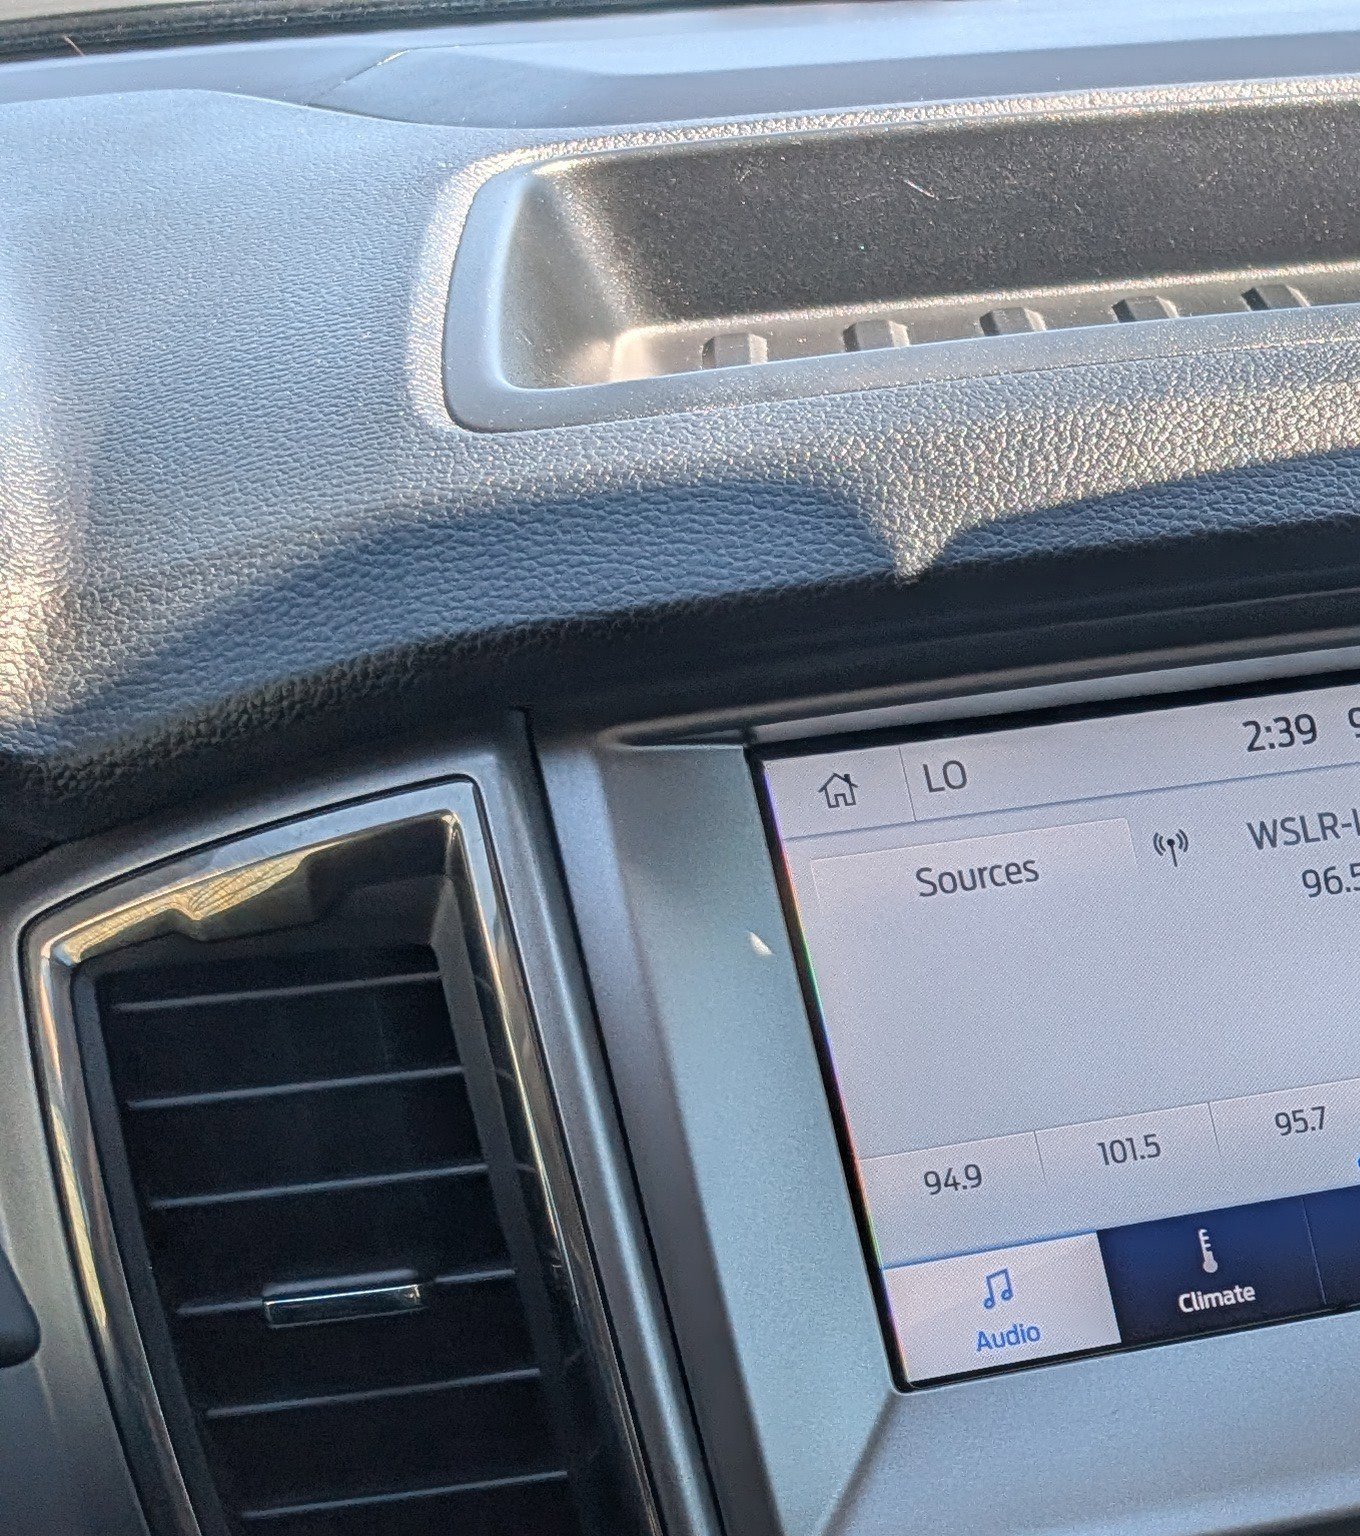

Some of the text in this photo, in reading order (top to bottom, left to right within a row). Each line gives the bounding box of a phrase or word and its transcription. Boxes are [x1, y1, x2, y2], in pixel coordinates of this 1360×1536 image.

[1242, 713, 1318, 753] 2:39
[922, 759, 969, 794] LO
[915, 858, 1040, 898] Sources
[1274, 1105, 1327, 1137] 95.7
[1097, 1133, 1163, 1168] 101.5
[923, 1164, 984, 1196] 94.9
[1177, 1283, 1257, 1315] Climate
[975, 1322, 1042, 1354] Audio
